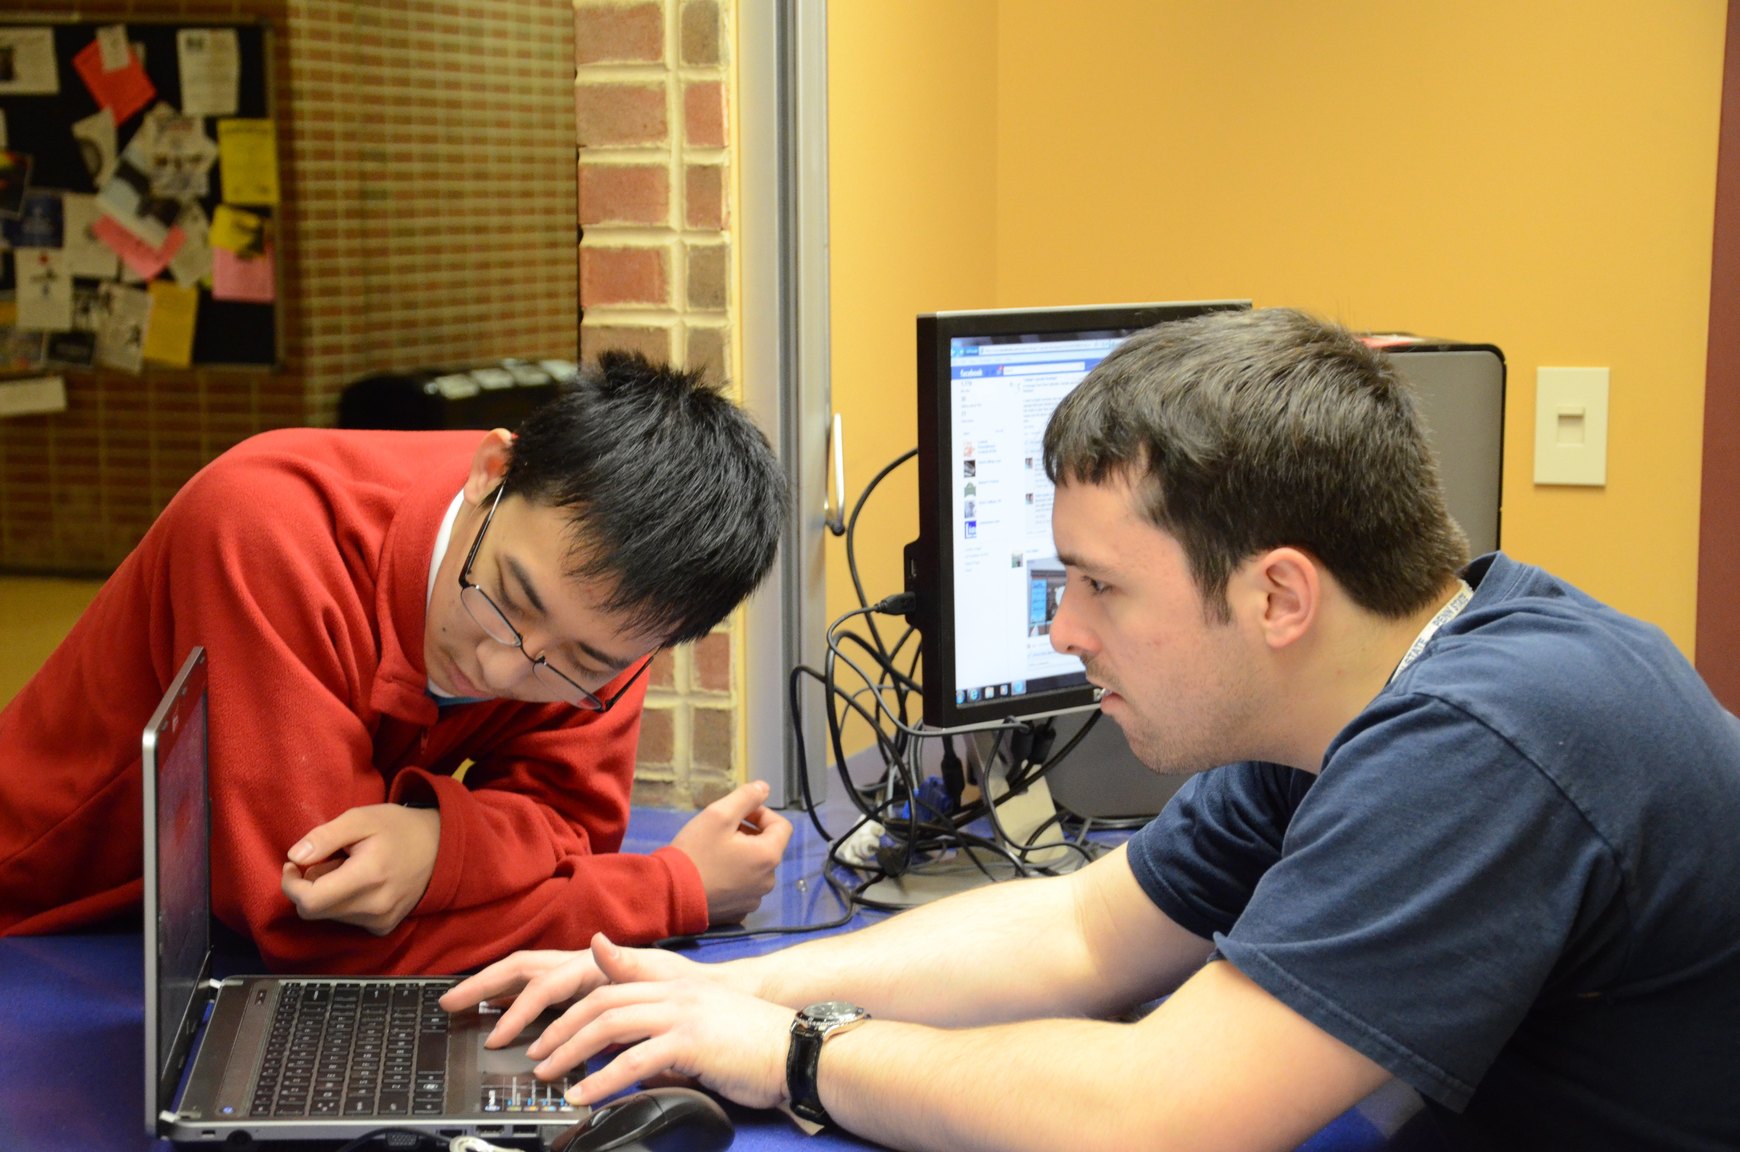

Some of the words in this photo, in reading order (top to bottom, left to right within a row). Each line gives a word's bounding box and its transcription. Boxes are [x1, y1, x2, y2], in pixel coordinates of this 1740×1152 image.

[1433, 608, 1453, 626] PENN
[1450, 593, 1469, 610] STATE
[1405, 638, 1426, 663] STATE
